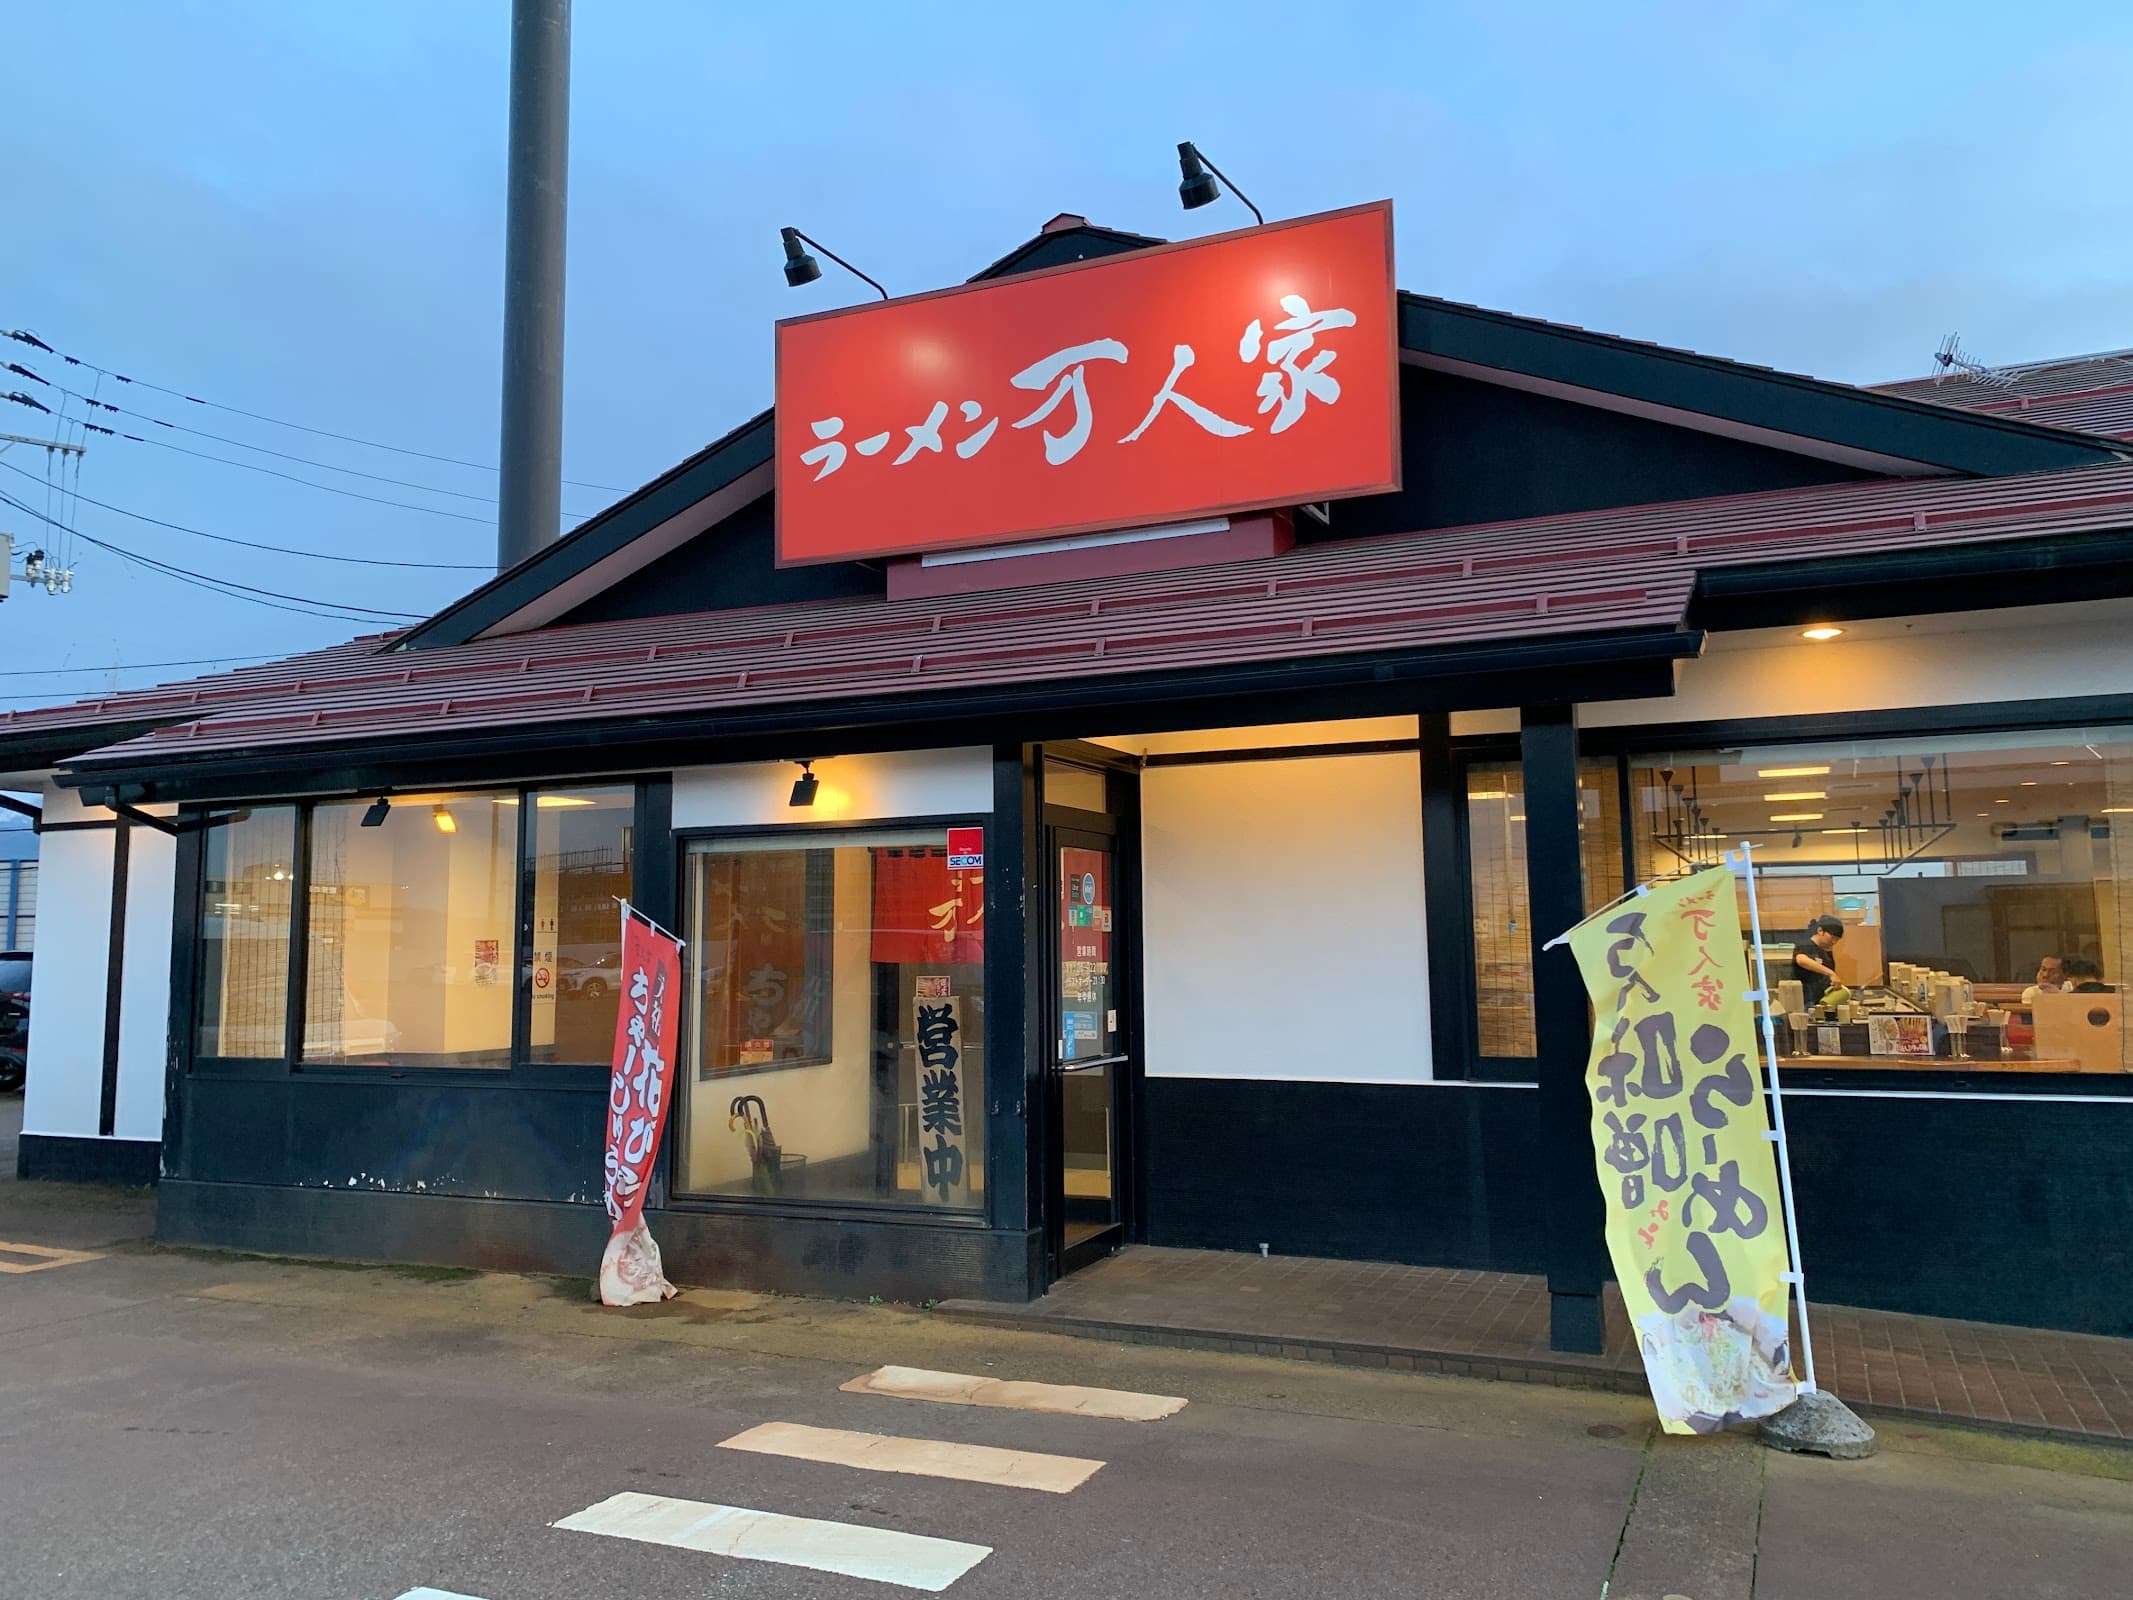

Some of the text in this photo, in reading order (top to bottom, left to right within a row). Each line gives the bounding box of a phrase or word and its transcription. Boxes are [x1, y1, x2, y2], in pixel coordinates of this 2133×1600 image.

[949, 856, 982, 866] SECOM
[916, 1003, 964, 1200] 営業中
